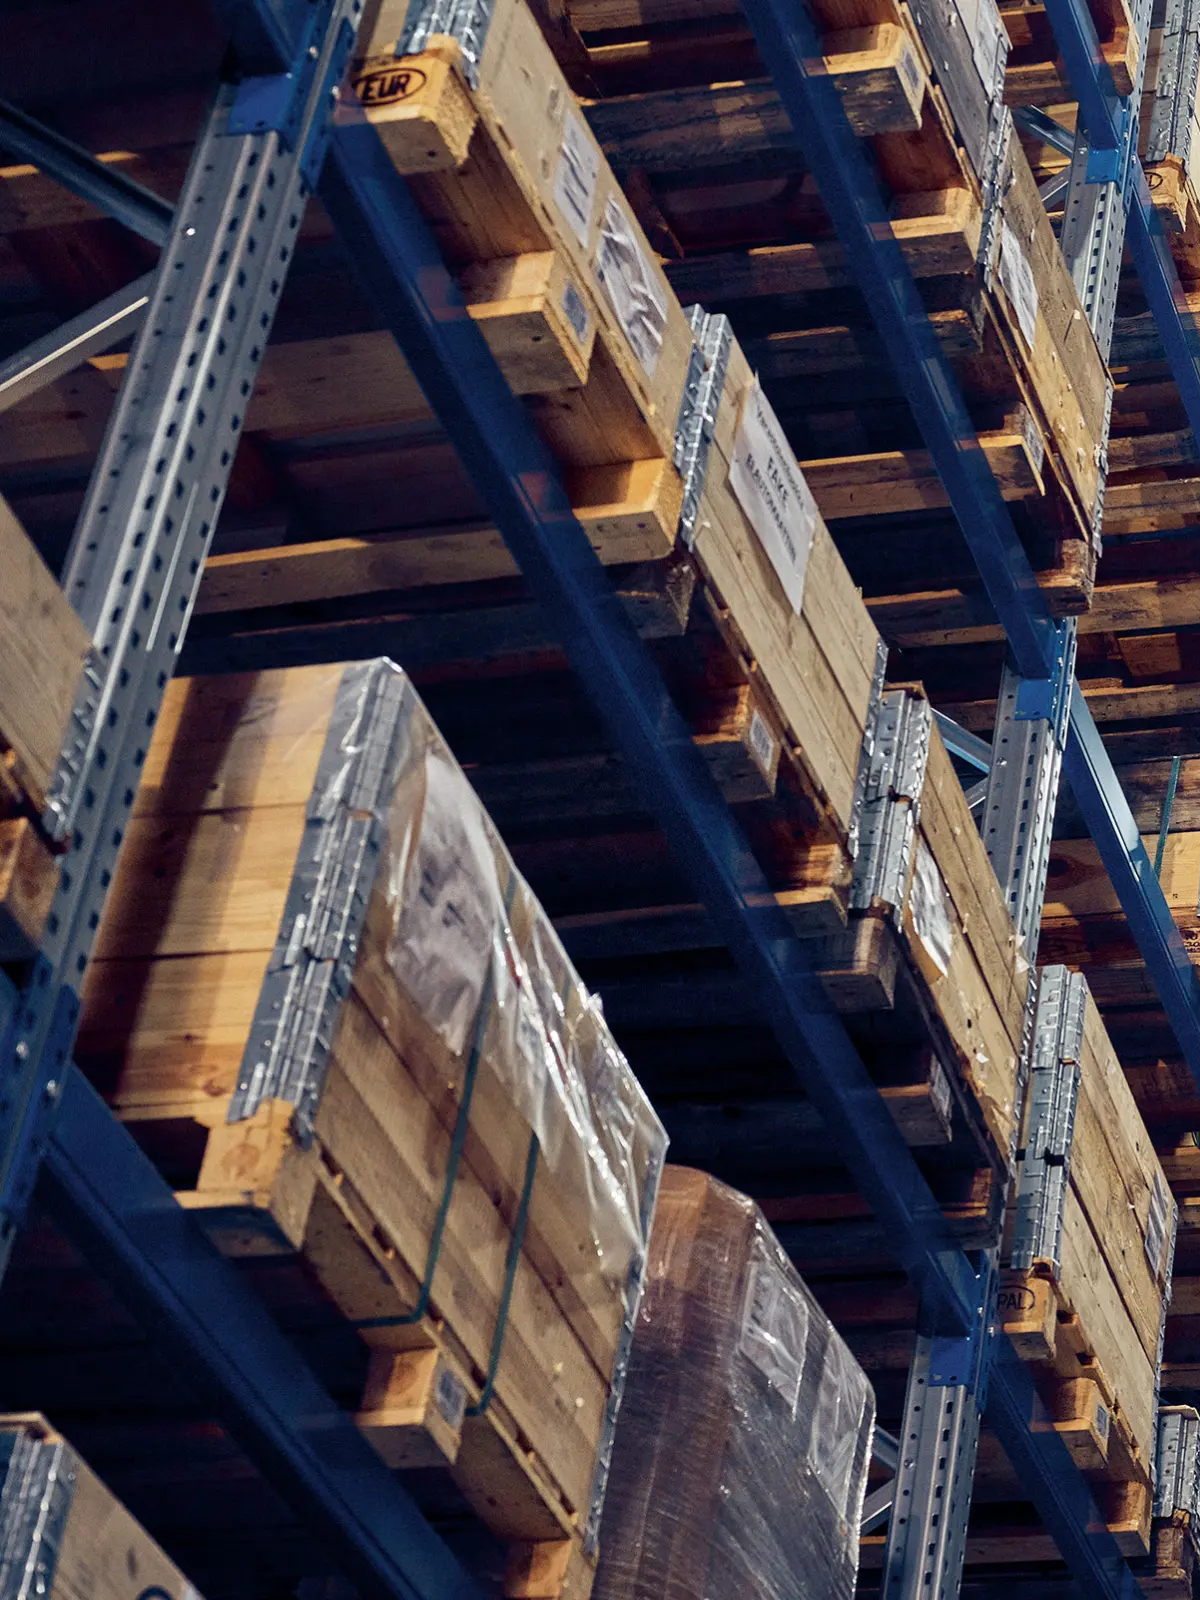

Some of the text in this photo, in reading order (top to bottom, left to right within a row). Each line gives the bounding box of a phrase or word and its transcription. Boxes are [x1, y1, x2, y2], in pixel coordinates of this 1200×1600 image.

[362, 73, 411, 101] EUR
[765, 455, 789, 511] FAKE
[996, 1291, 1026, 1310] PAL
